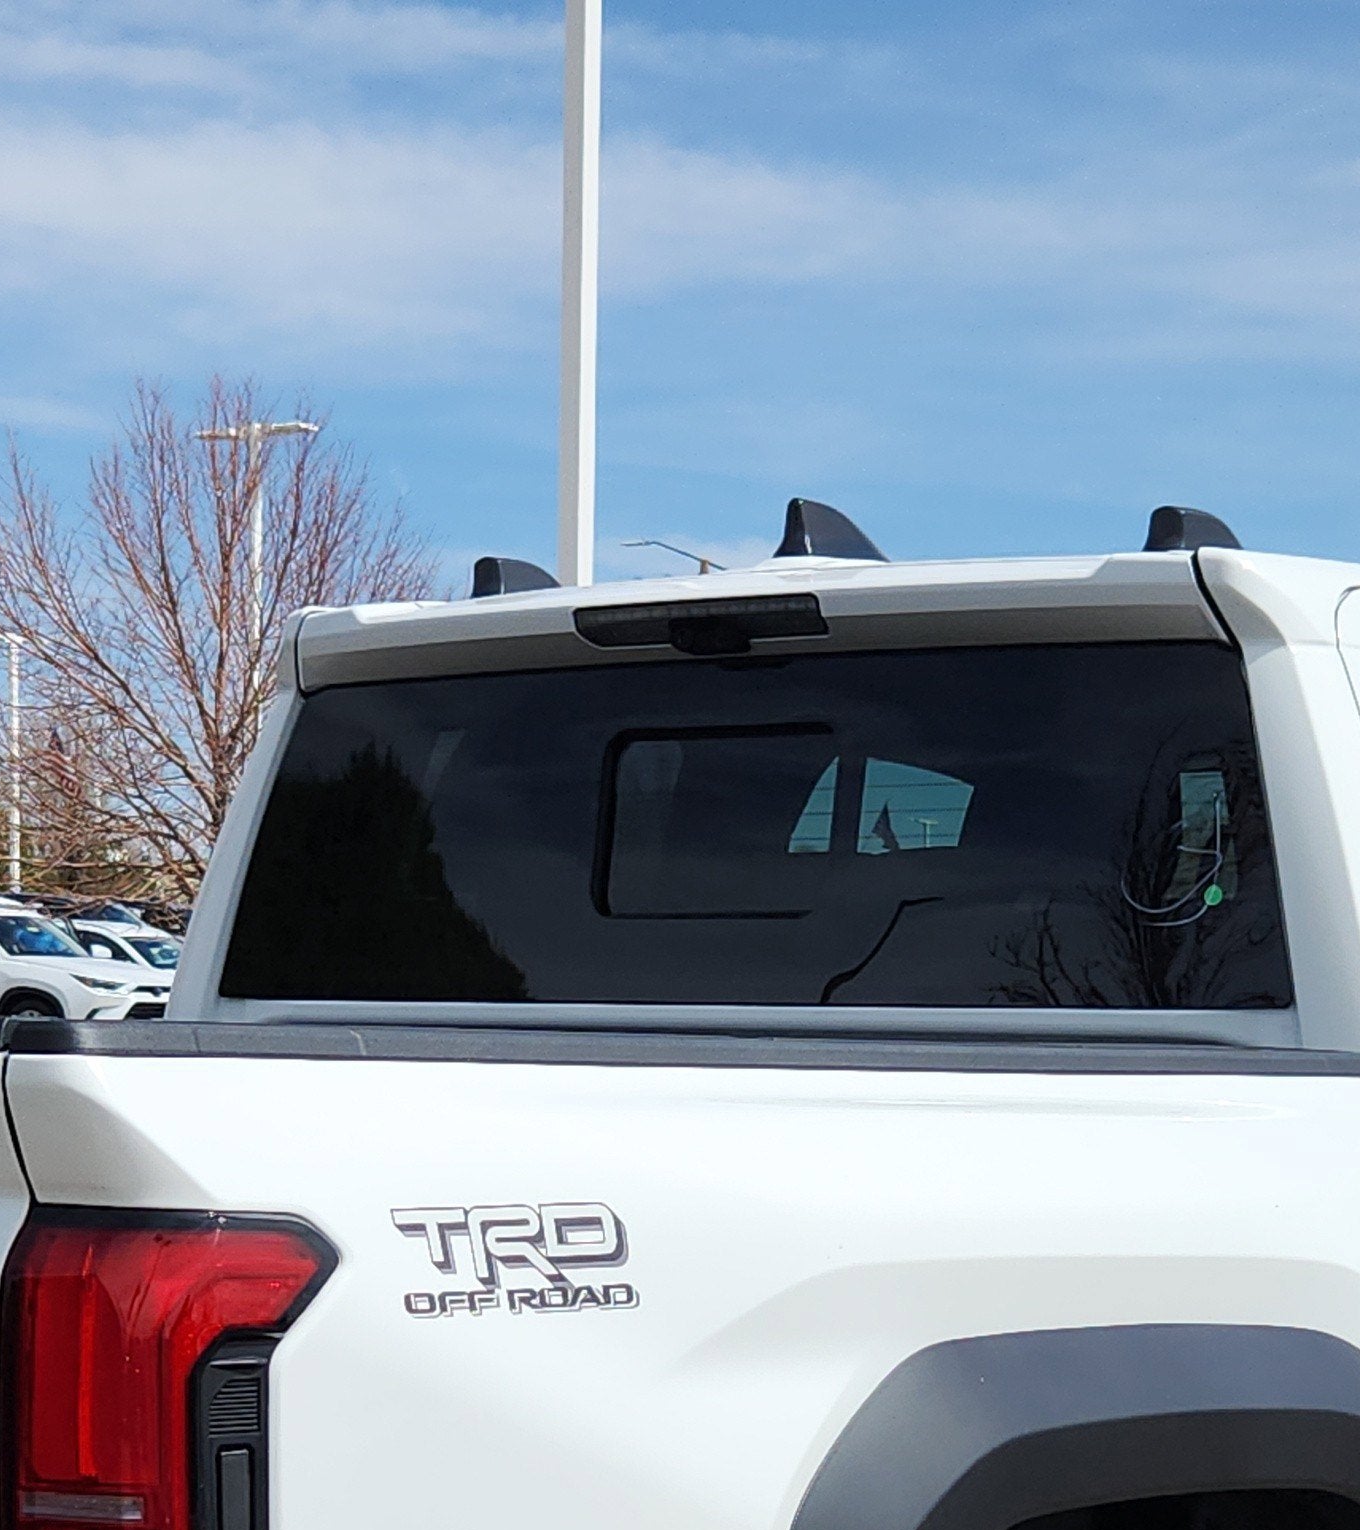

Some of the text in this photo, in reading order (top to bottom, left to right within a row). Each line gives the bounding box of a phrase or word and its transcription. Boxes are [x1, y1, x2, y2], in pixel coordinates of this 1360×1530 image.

[390, 1202, 630, 1290] TRD
[403, 1284, 640, 1319] OFF ROAD
